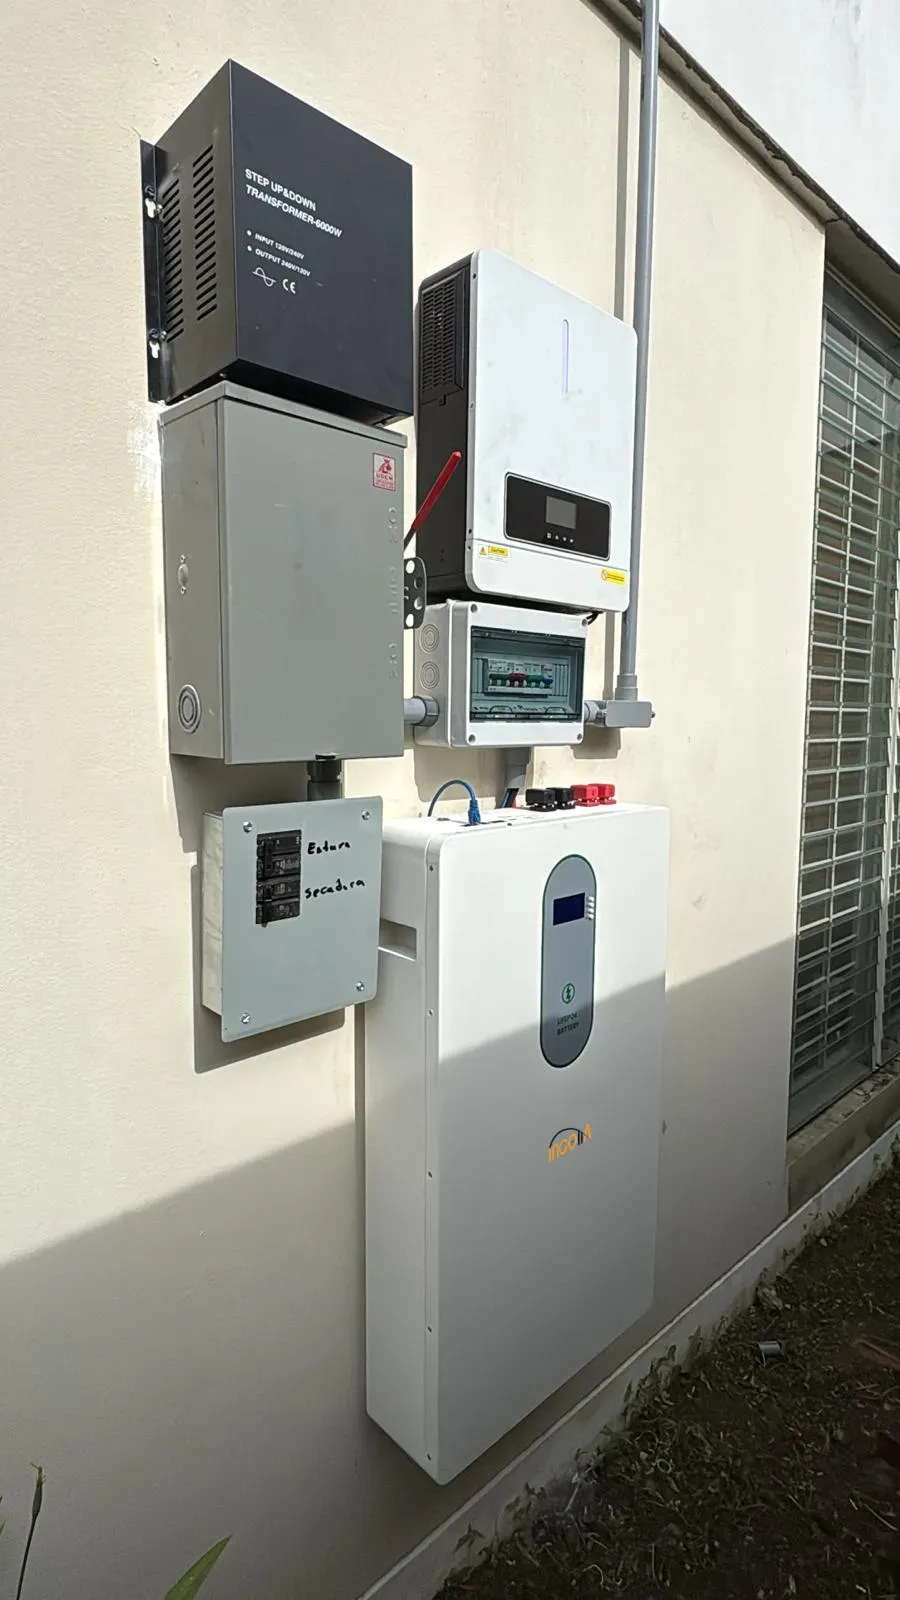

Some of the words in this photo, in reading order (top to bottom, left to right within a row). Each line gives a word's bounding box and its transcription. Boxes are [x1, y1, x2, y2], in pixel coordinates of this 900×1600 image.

[245, 168, 269, 187] STEP
[270, 181, 316, 211] UP&DOWN
[246, 184, 343, 238] TRANSFORMER-6000W
[255, 233, 274, 246] INPUT
[255, 248, 281, 264] OUTPUT
